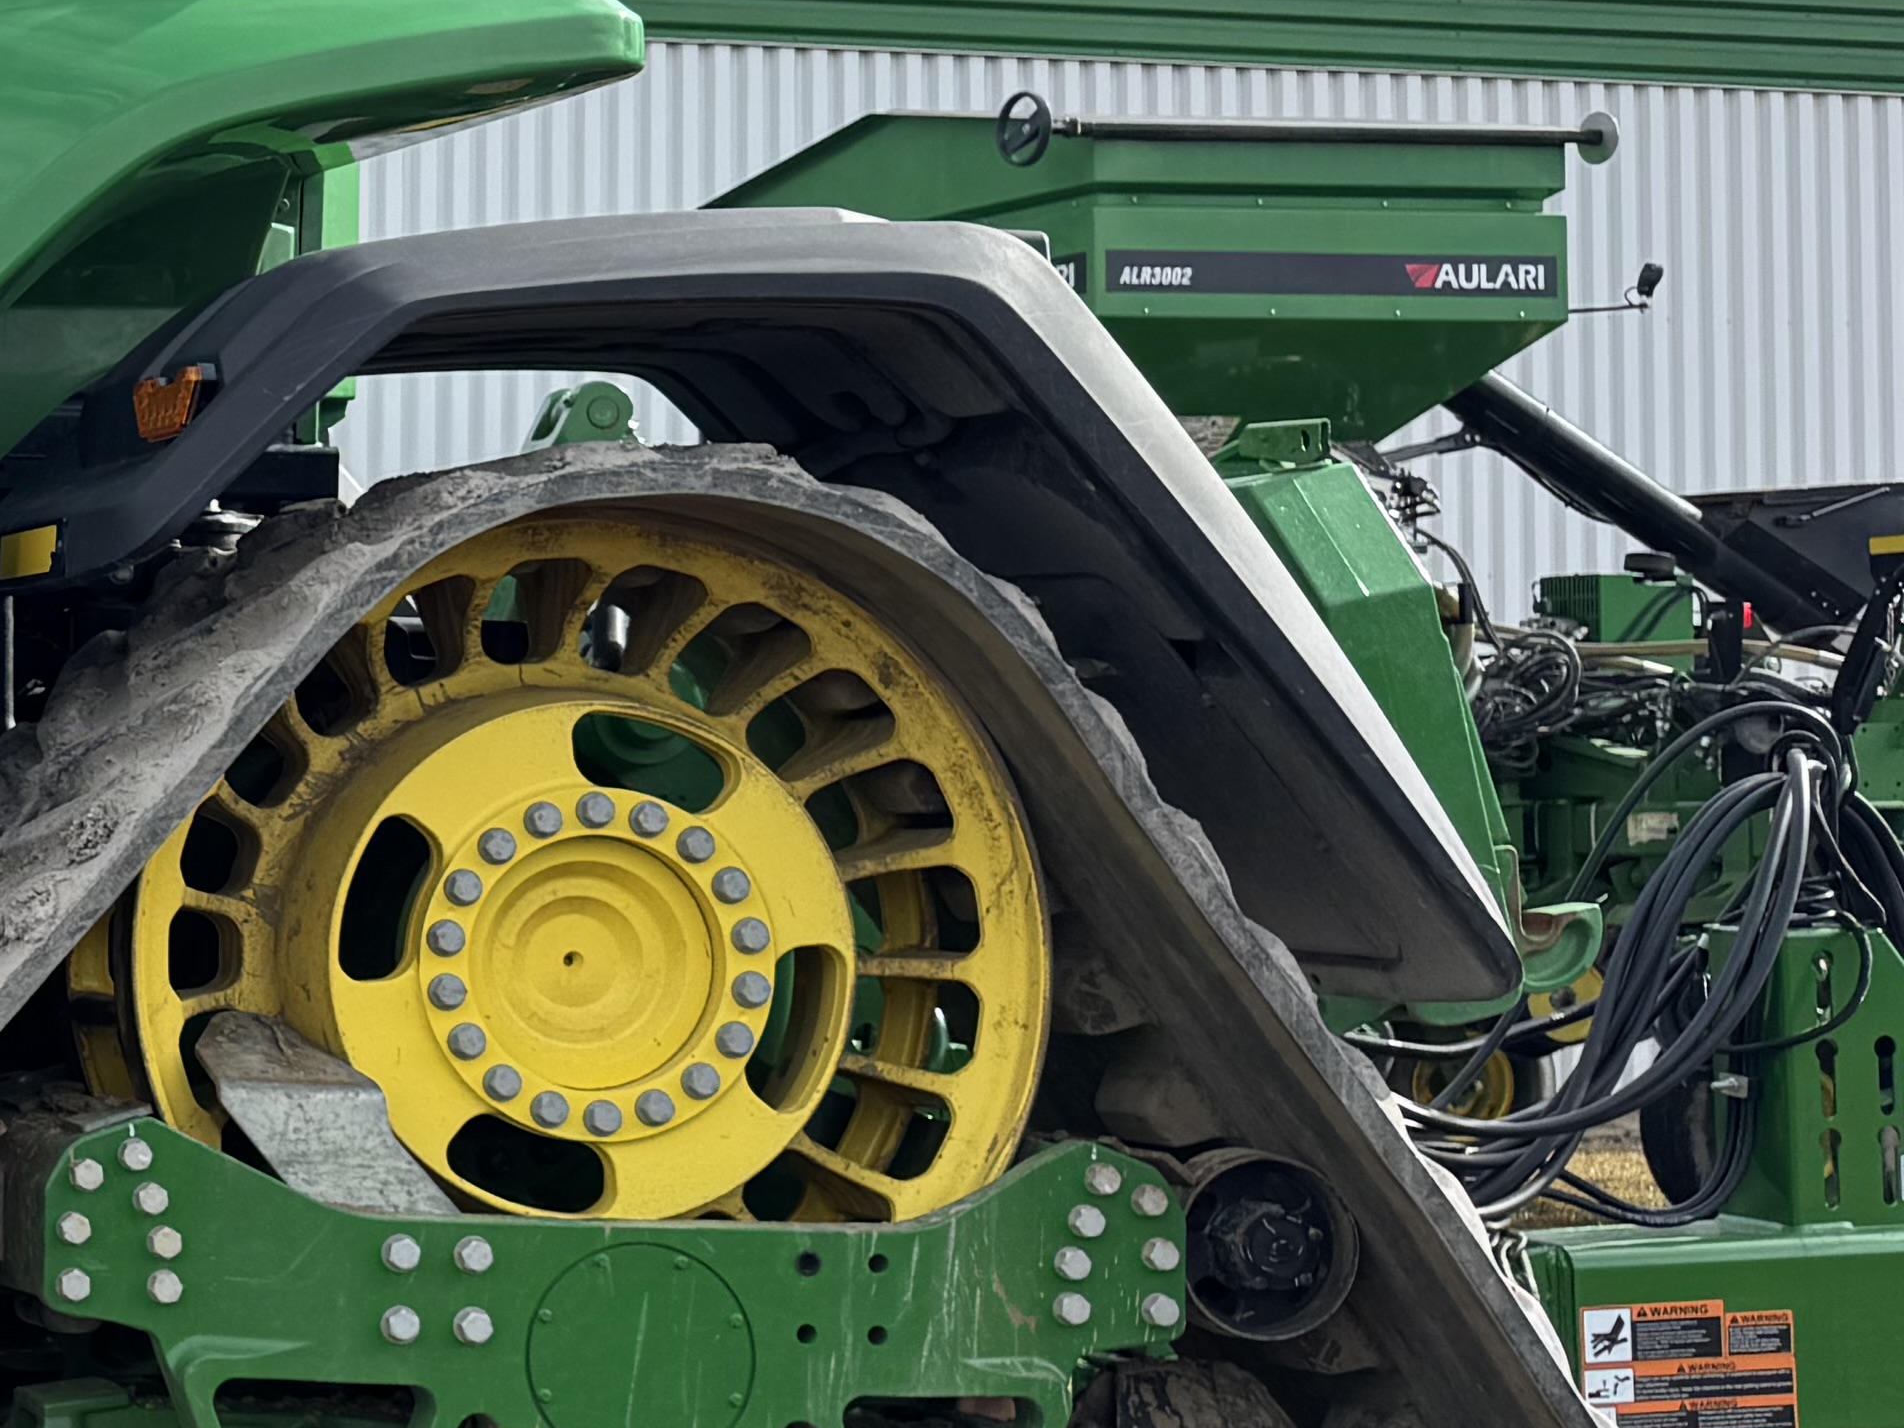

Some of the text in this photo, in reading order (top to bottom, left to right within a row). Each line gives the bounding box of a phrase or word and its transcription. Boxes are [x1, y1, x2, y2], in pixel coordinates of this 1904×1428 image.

[1119, 265, 1193, 286] ALR3002
[1434, 263, 1546, 291] AULARI
[1649, 1303, 1709, 1317] WARNING
[1739, 1312, 1790, 1323] WARNING
[1687, 1361, 1737, 1372] WARNING
